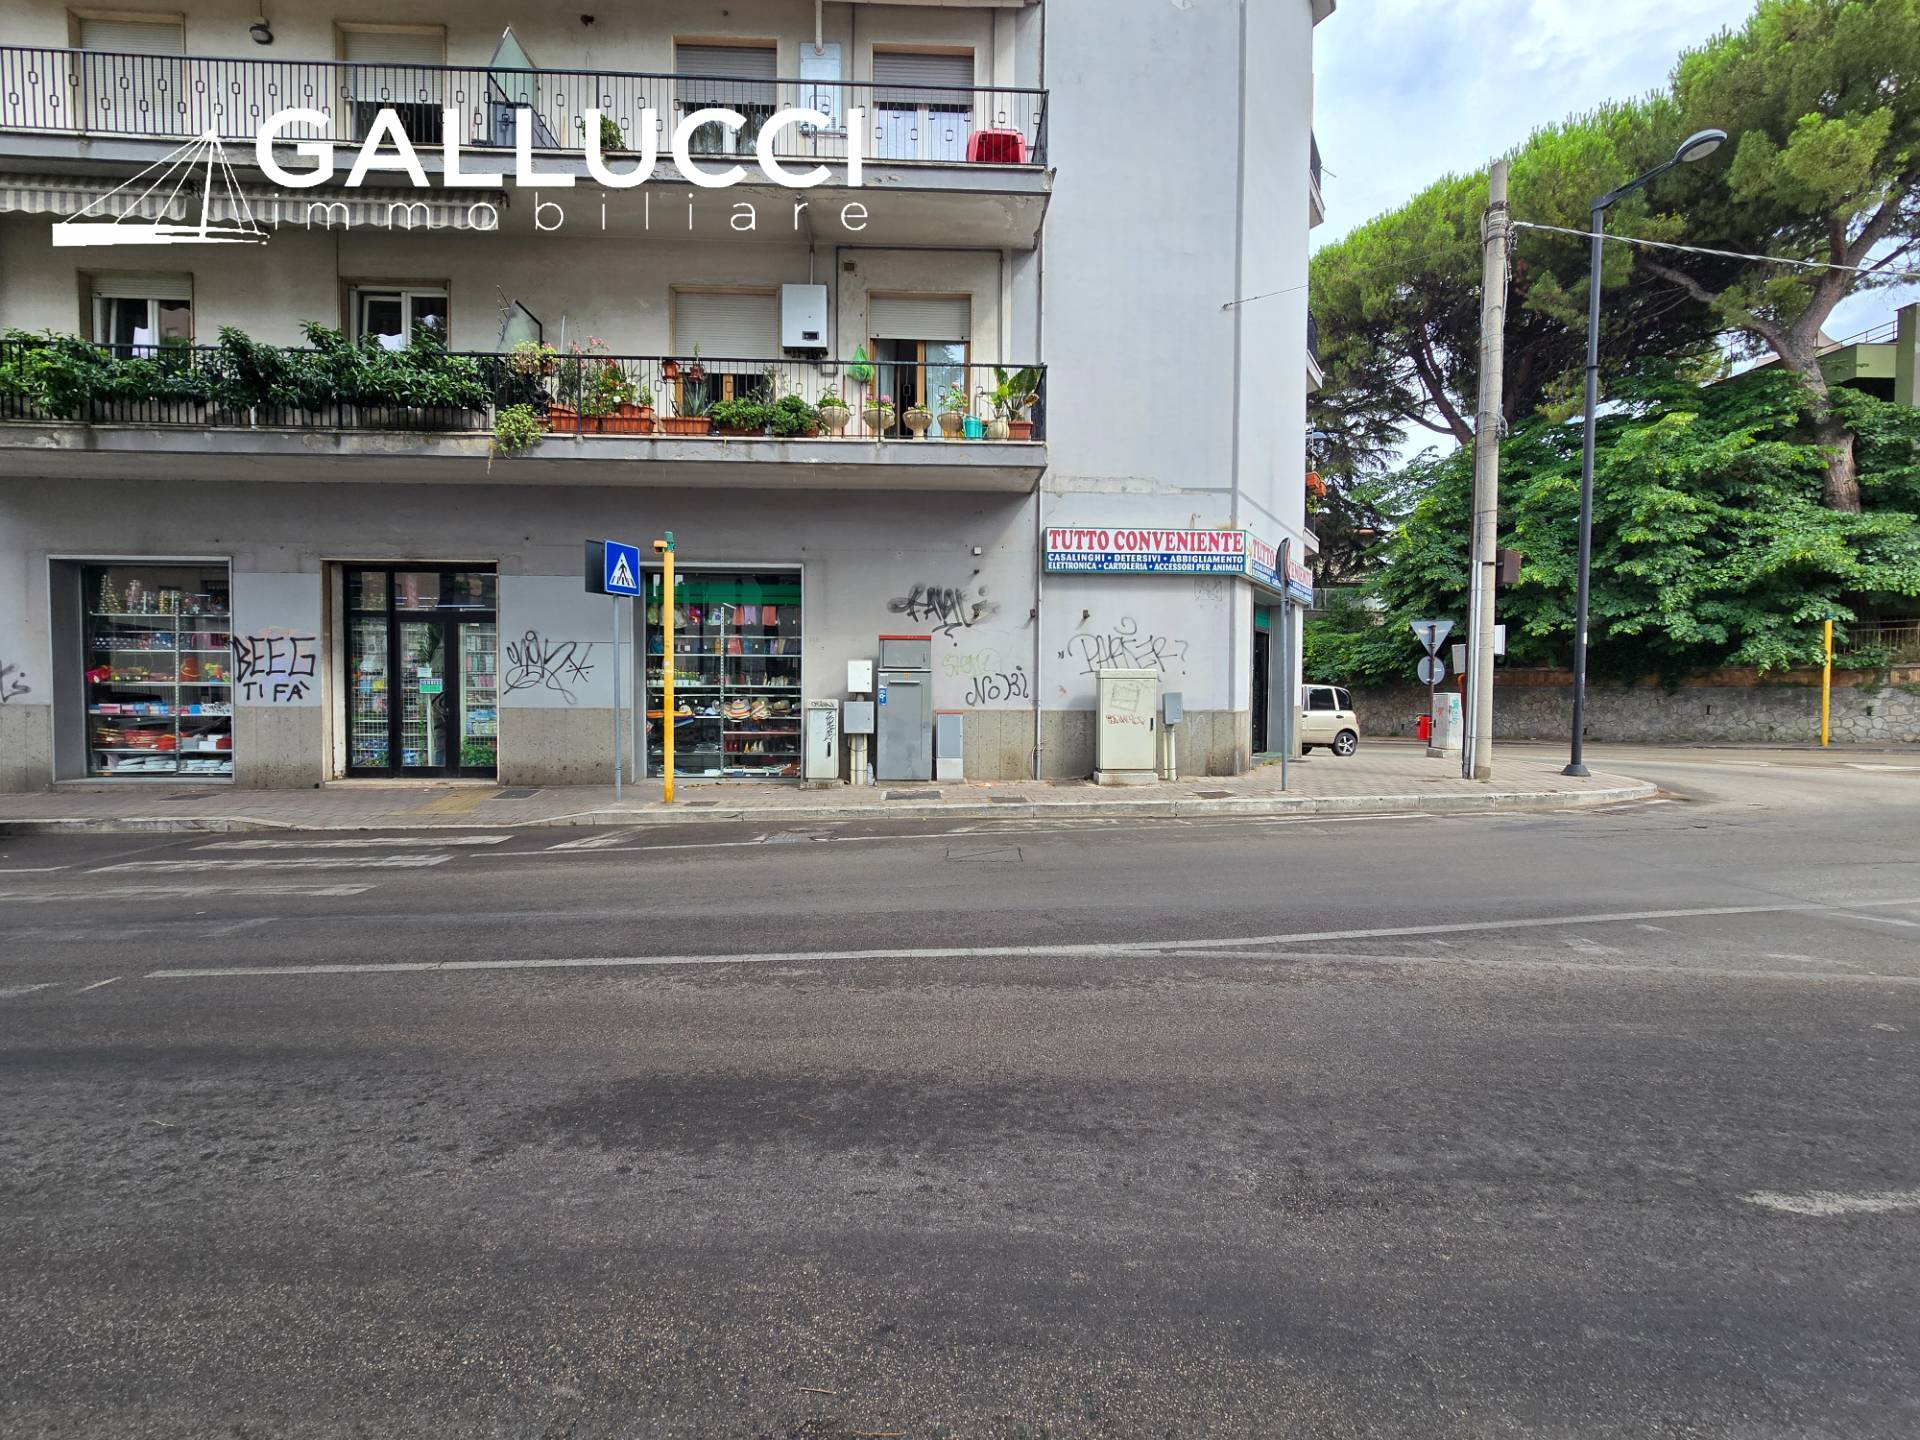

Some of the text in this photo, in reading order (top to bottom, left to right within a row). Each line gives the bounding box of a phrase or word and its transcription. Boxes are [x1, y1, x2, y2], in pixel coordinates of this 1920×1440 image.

[1049, 529, 1244, 553] TUTTO CONVENIENTE
[1047, 553, 1244, 564] CASALINGHI DETERSIVI ABBIGLIAMENTO
[1047, 561, 1097, 570] ELETTRONICA
[1103, 562, 1148, 571] CARTOLERIA
[1153, 563, 1195, 571] ACCESSORI
[1196, 563, 1211, 572] PER
[1212, 563, 1244, 572] ANIMALI
[229, 635, 317, 683] BEEG
[242, 681, 264, 701] TI
